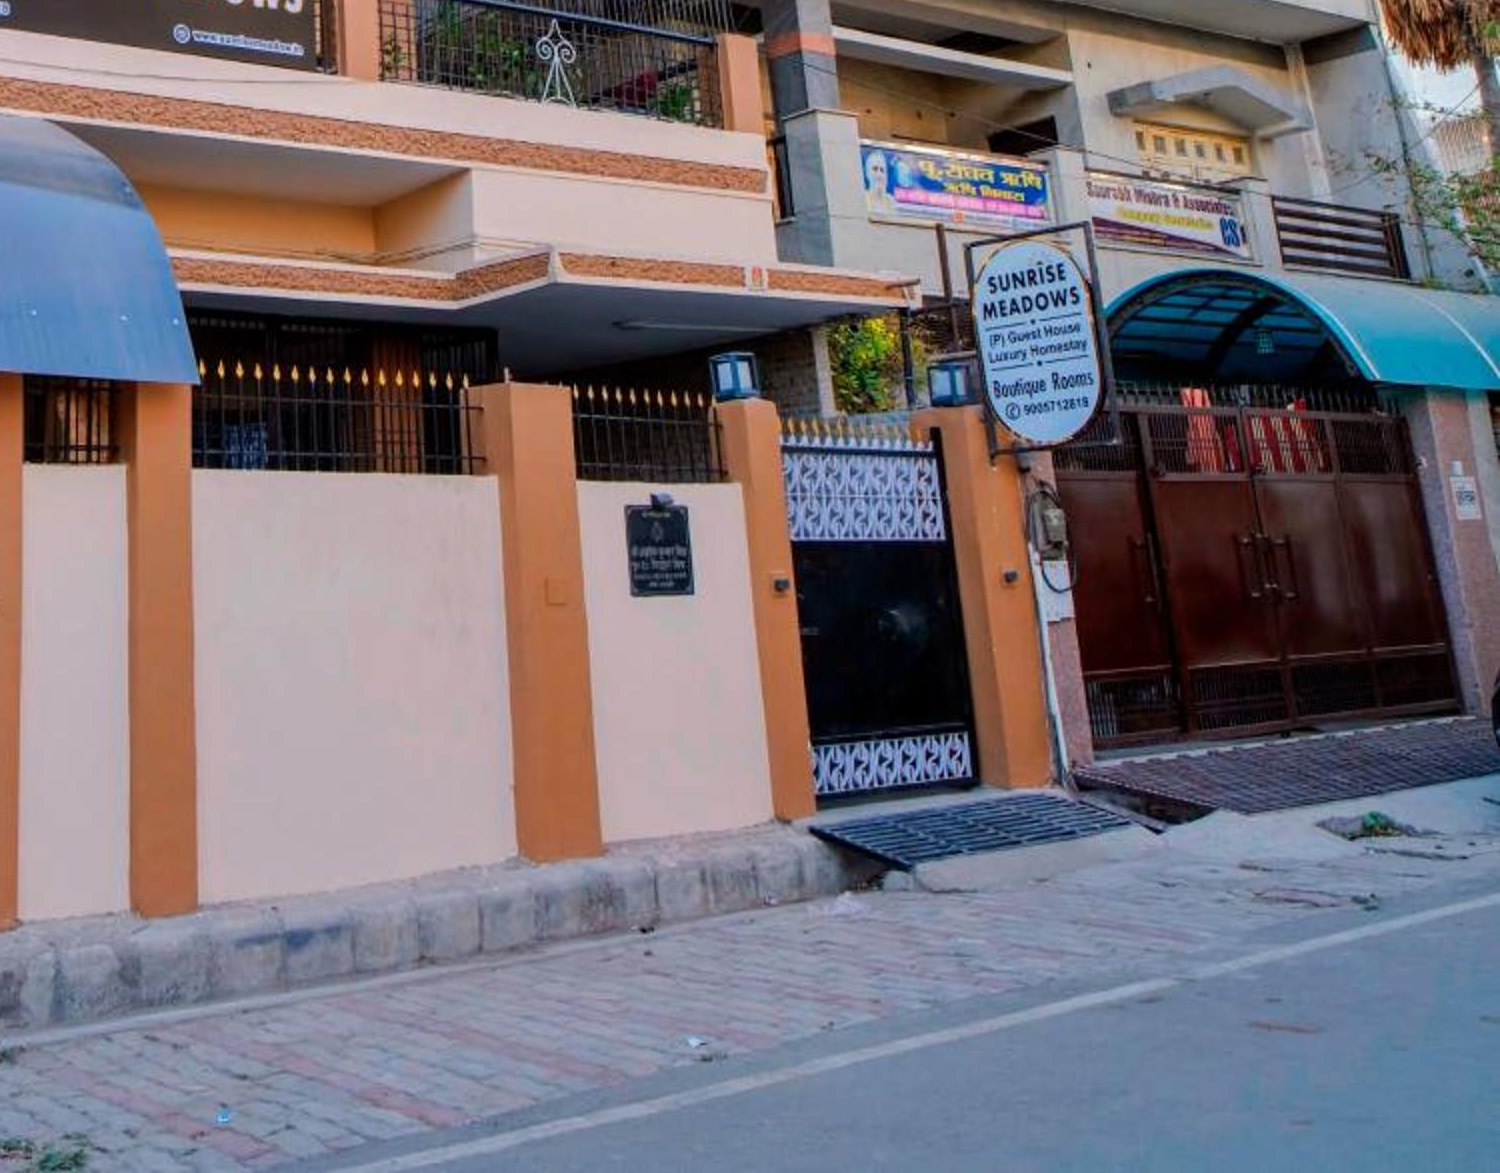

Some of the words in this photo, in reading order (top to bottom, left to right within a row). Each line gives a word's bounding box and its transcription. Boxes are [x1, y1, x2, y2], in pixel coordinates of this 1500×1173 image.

[988, 262, 1067, 294] SUNRISE
[983, 286, 1080, 321] MEADOWS
[1008, 329, 1041, 343] Guest
[1044, 323, 1081, 337] House
[989, 349, 1027, 363] Luxury
[1030, 339, 1088, 355] Homestay
[993, 378, 1046, 399] Boutique
[1051, 372, 1094, 392] Rooms
